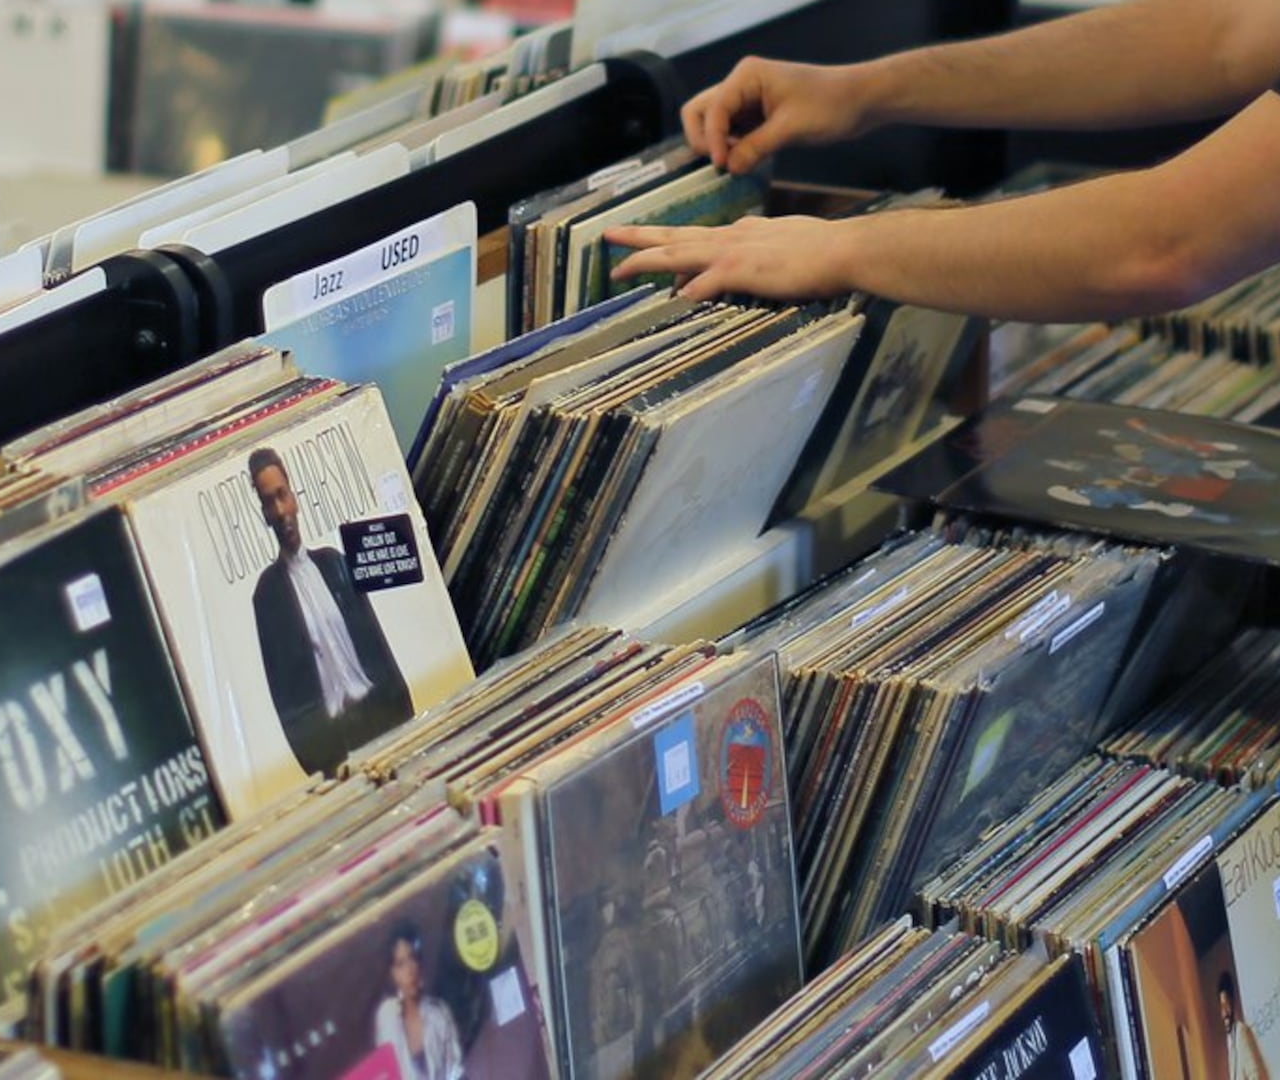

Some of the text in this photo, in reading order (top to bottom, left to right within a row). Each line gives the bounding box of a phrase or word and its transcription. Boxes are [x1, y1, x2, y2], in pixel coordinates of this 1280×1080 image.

[312, 234, 420, 300] Jazz USED
[21, 745, 208, 886] PRODUCTIONS
[1221, 844, 1249, 909] Earl
